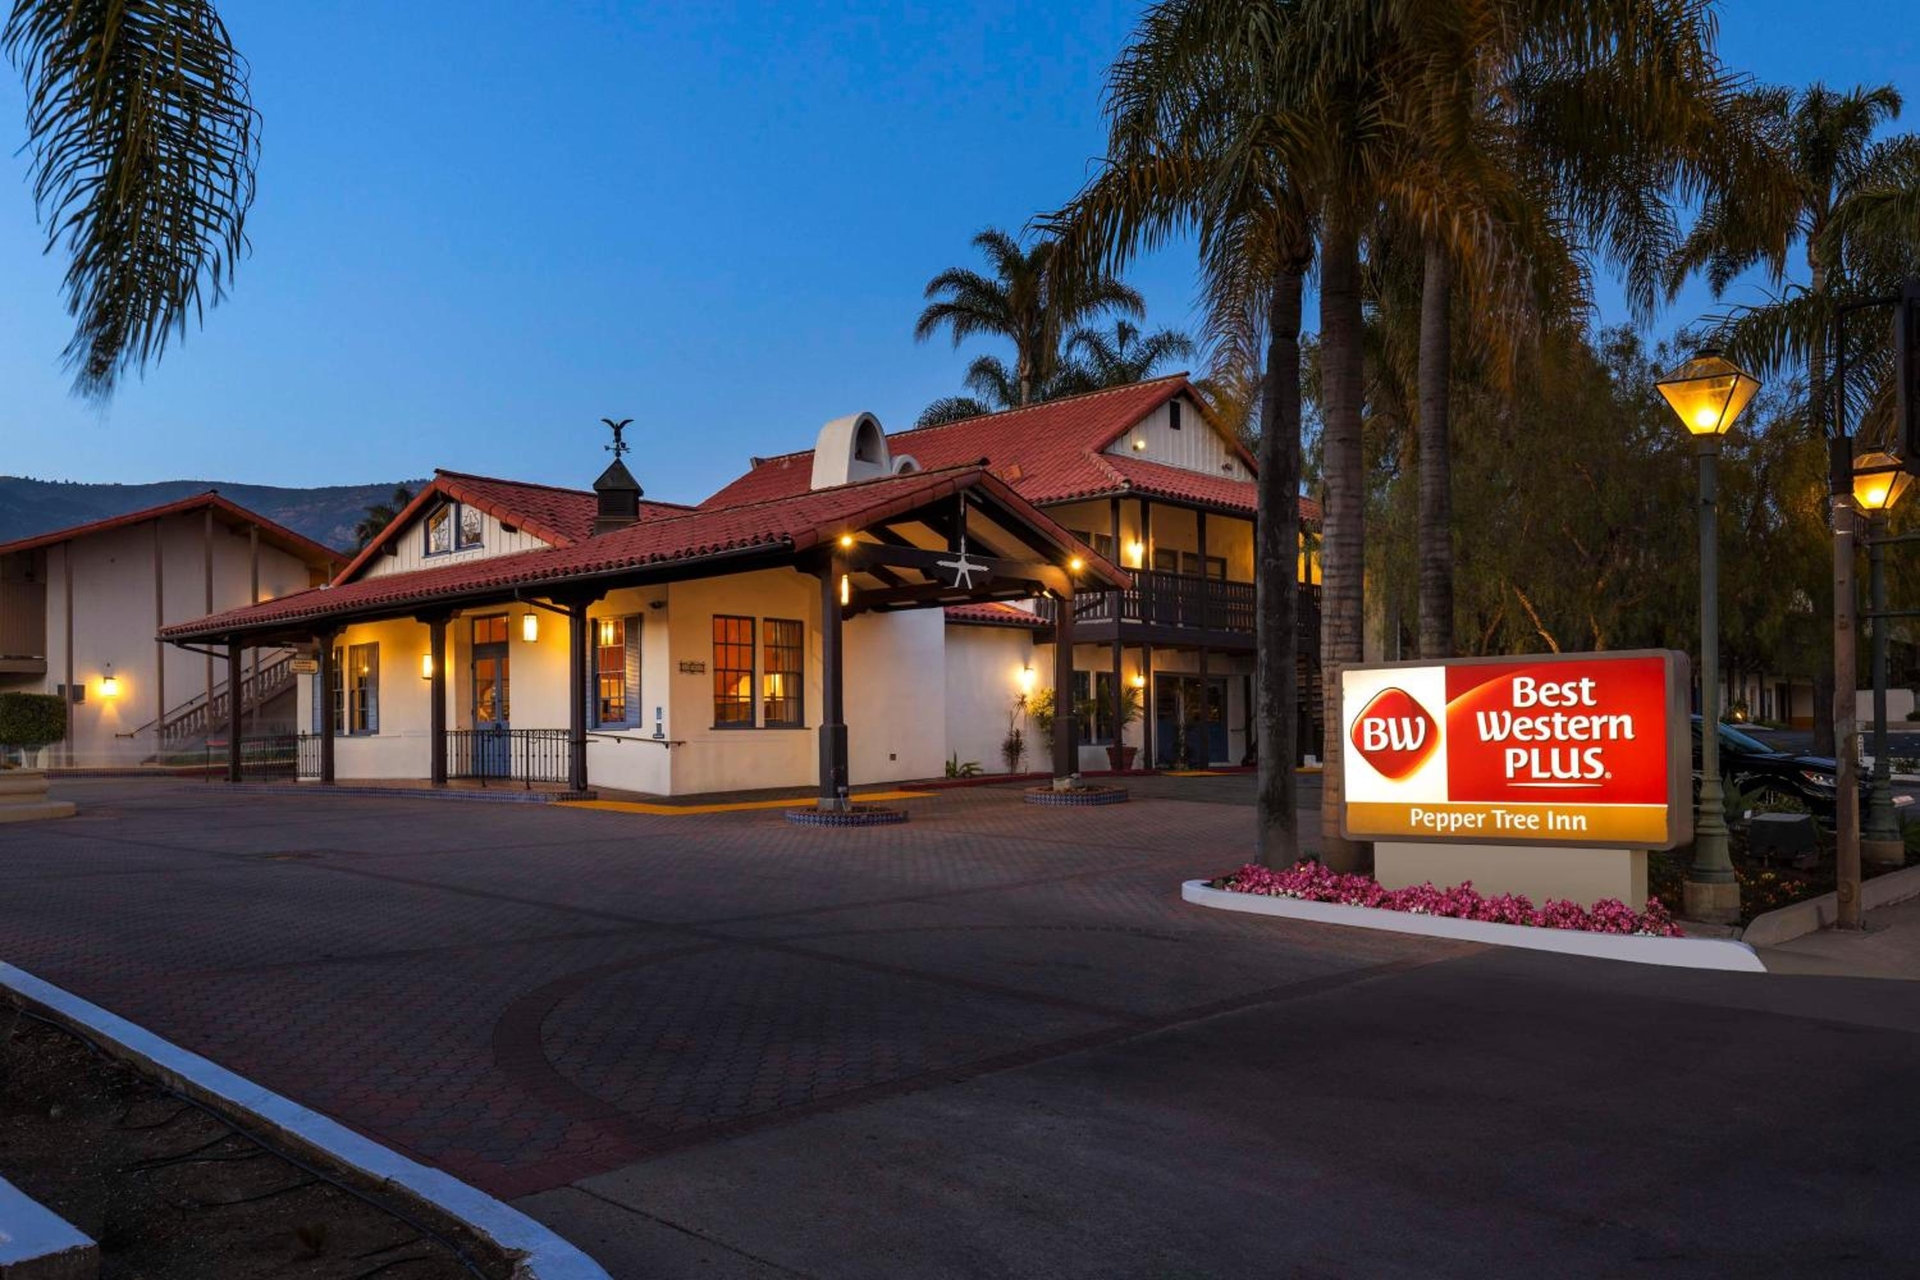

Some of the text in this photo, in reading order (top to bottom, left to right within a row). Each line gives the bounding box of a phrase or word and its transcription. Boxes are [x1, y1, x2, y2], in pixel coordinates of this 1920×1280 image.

[1512, 676, 1598, 708] Best
[1363, 716, 1427, 751] BW
[1476, 710, 1636, 741] Western
[1410, 808, 1588, 831] Pepper Tree Inn
